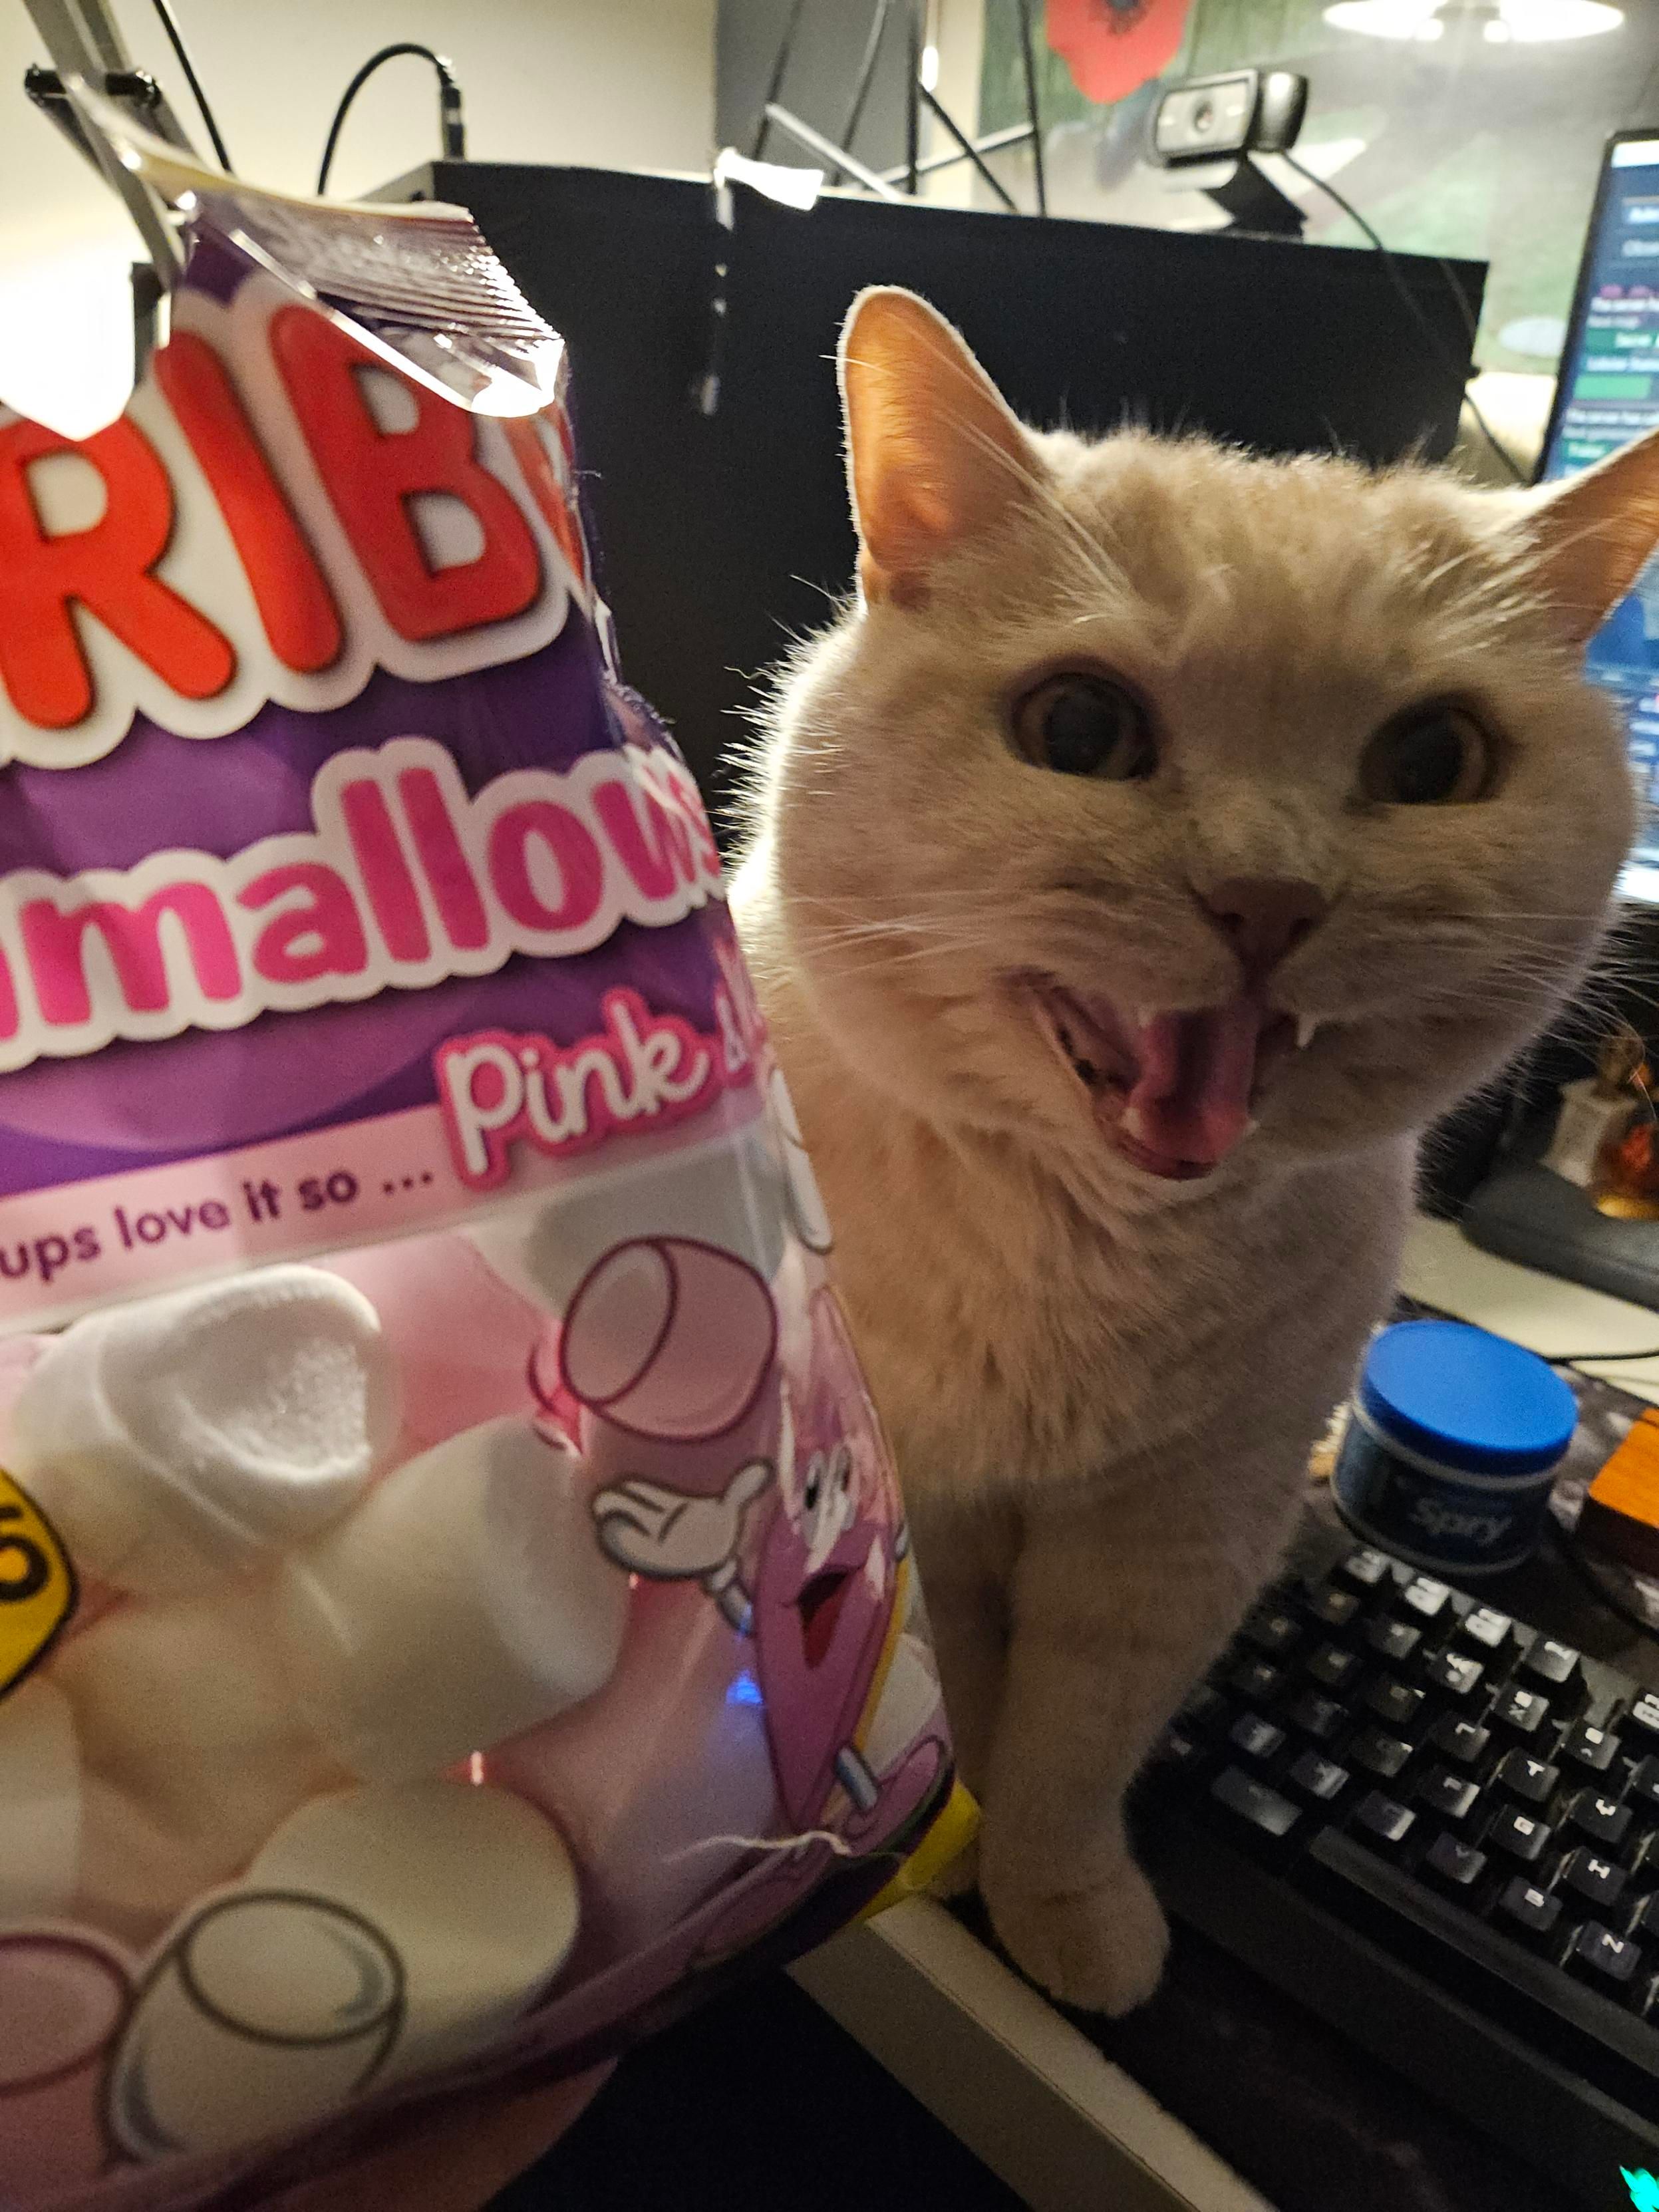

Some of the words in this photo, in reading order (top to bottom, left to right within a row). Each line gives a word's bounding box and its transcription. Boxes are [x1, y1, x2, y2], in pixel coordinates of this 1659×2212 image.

[444, 999, 710, 1176] Pink
[112, 1198, 231, 1251] love
[242, 1178, 282, 1223] it
[297, 1169, 359, 1212] so
